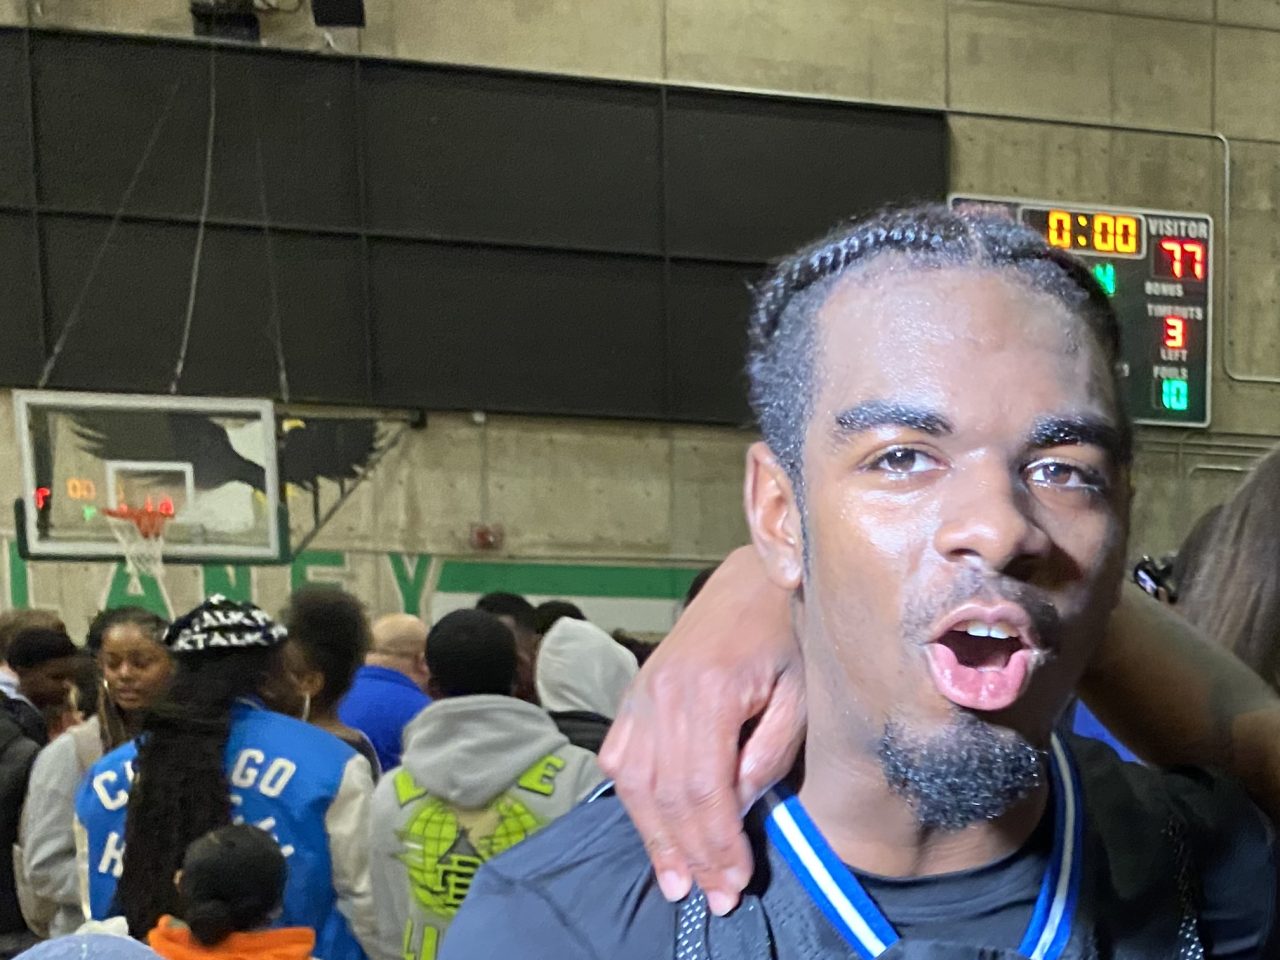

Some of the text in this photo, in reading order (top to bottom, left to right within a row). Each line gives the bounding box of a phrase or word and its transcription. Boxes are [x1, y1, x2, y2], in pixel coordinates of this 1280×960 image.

[1048, 209, 1137, 254] 0:00
[1147, 217, 1208, 239] VISITOR
[1160, 240, 1204, 280] 77
[1144, 281, 1183, 297] BONUS
[1147, 303, 1203, 321] TIMEOUTS
[1164, 317, 1184, 349] 3
[1160, 348, 1188, 362] LEFT
[1153, 365, 1188, 380] FOULS
[1161, 378, 1189, 411] 10
